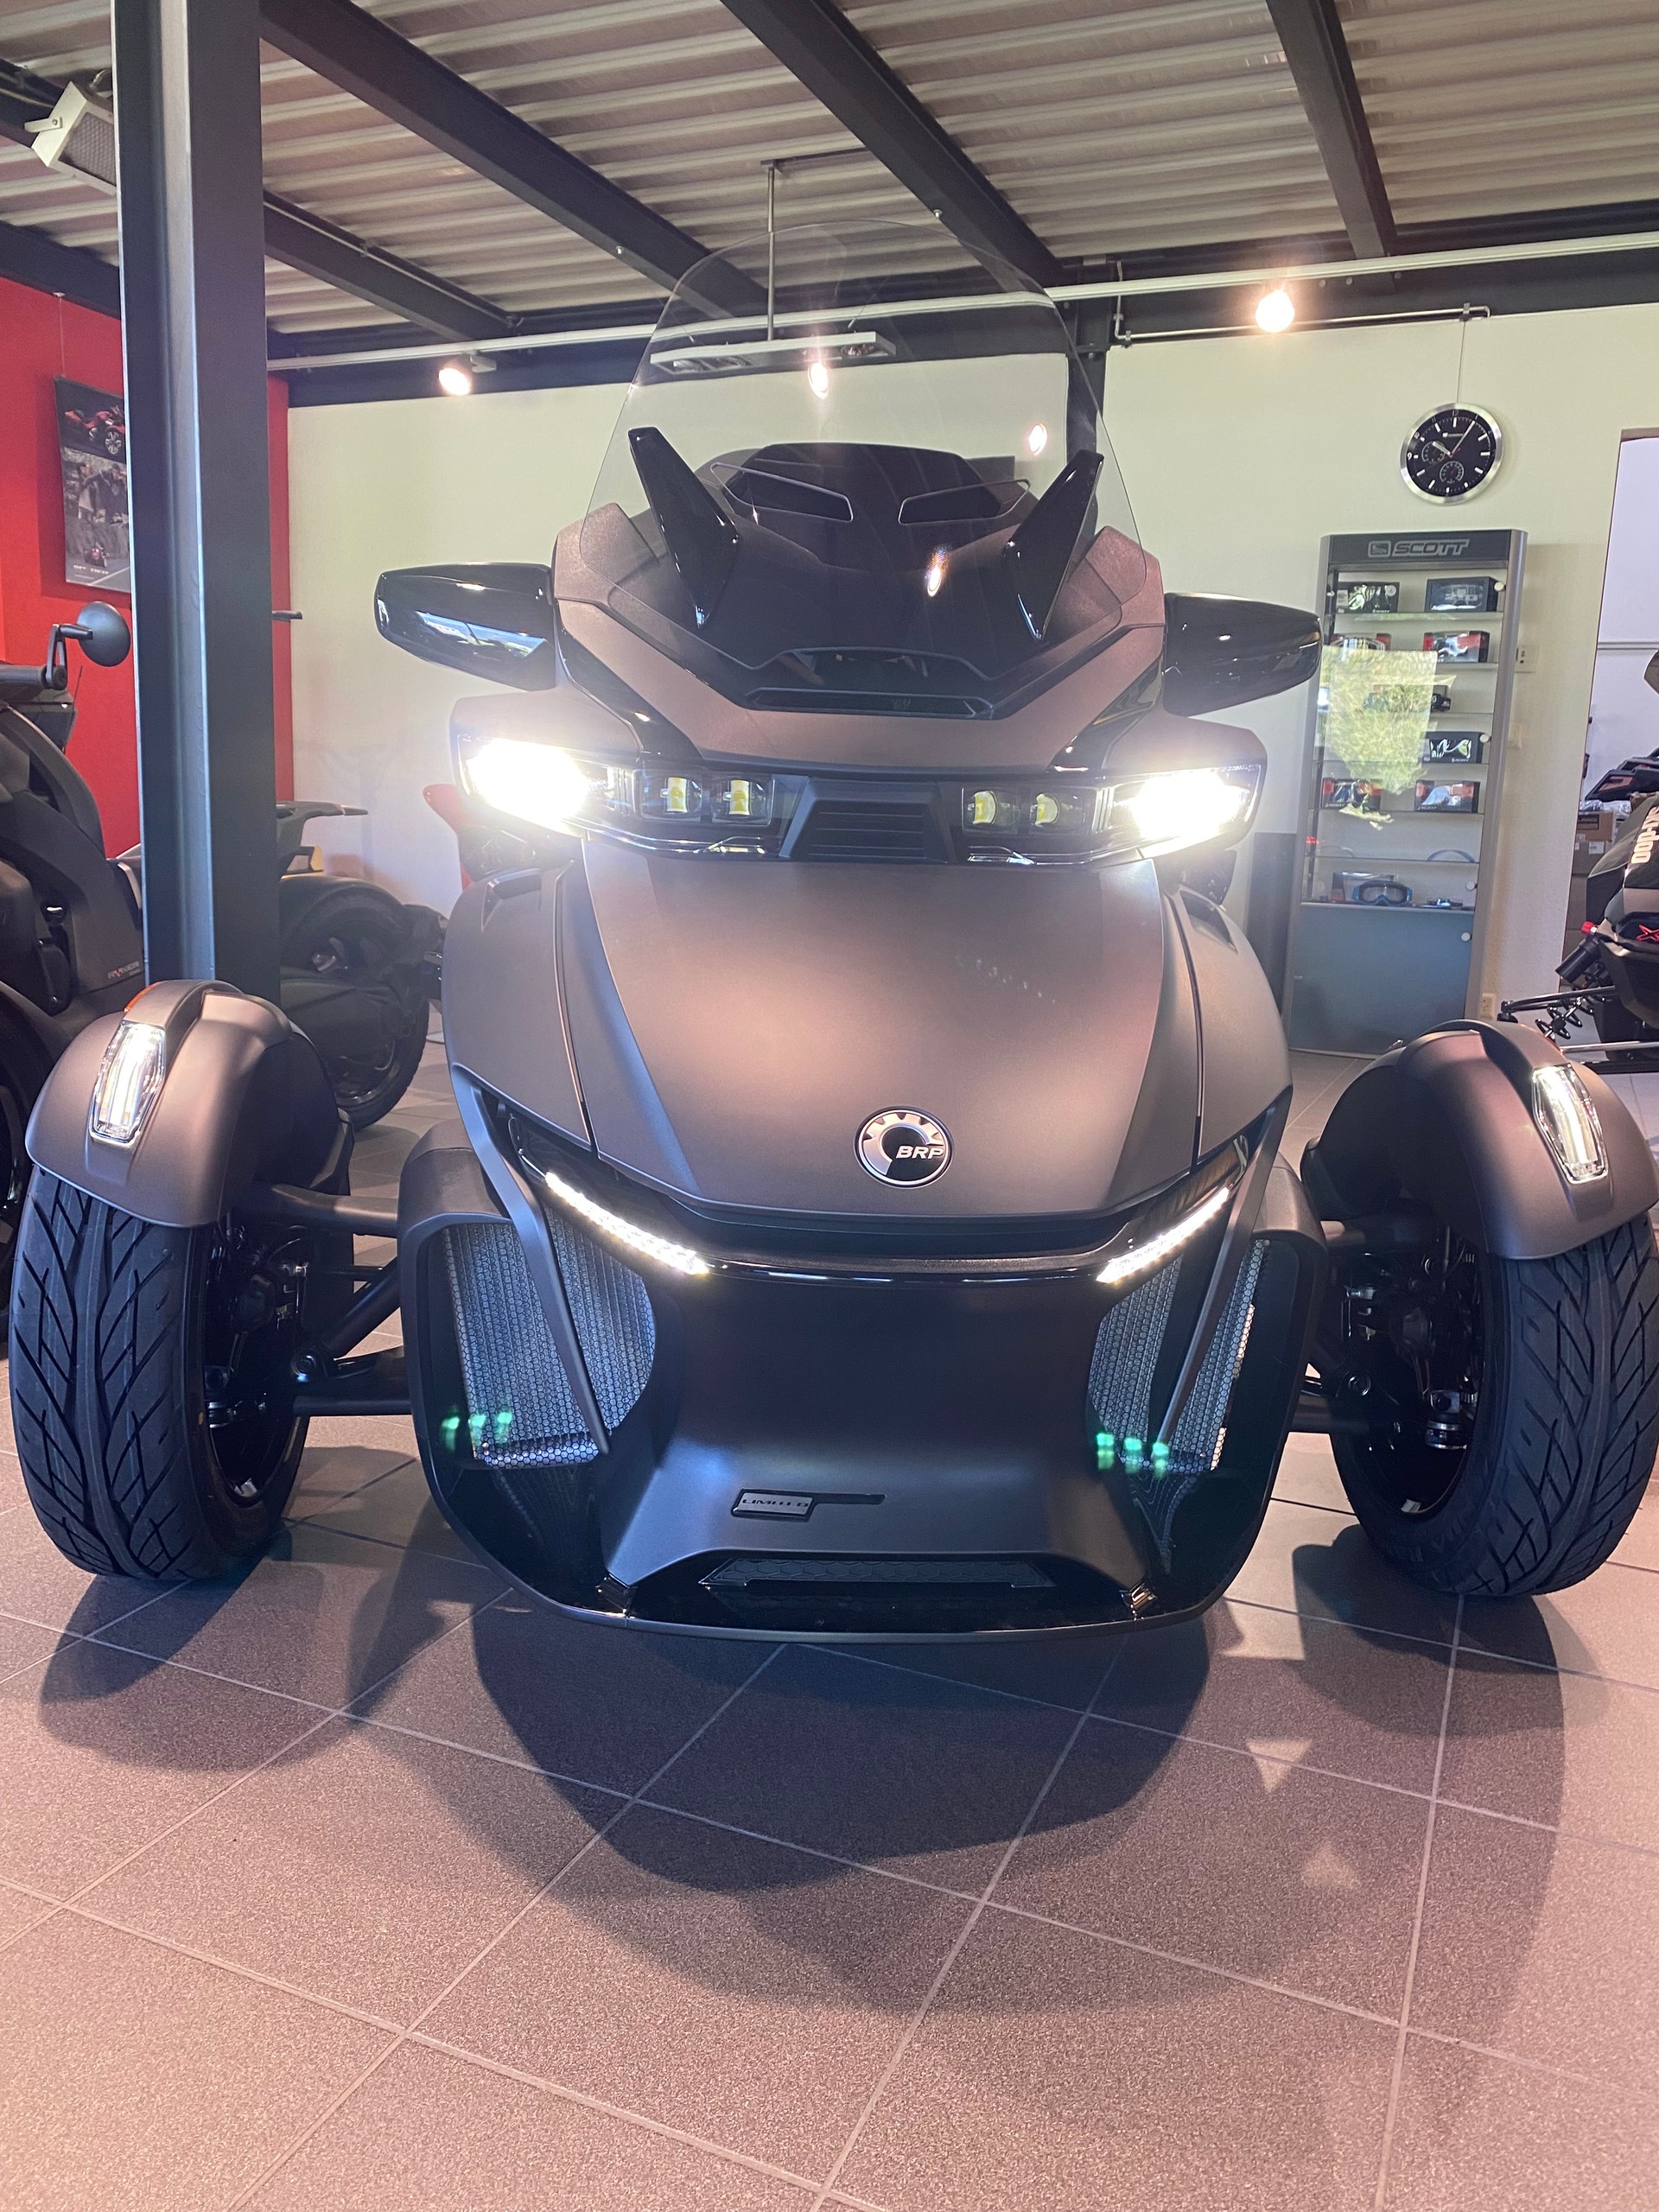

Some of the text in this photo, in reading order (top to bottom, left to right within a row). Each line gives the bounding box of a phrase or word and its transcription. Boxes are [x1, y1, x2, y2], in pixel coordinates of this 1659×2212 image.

[1407, 452, 1413, 461] 9
[1392, 539, 1470, 556] SCOTT
[895, 1145, 944, 1160] BRP
[741, 1498, 809, 1508] LIMITED
